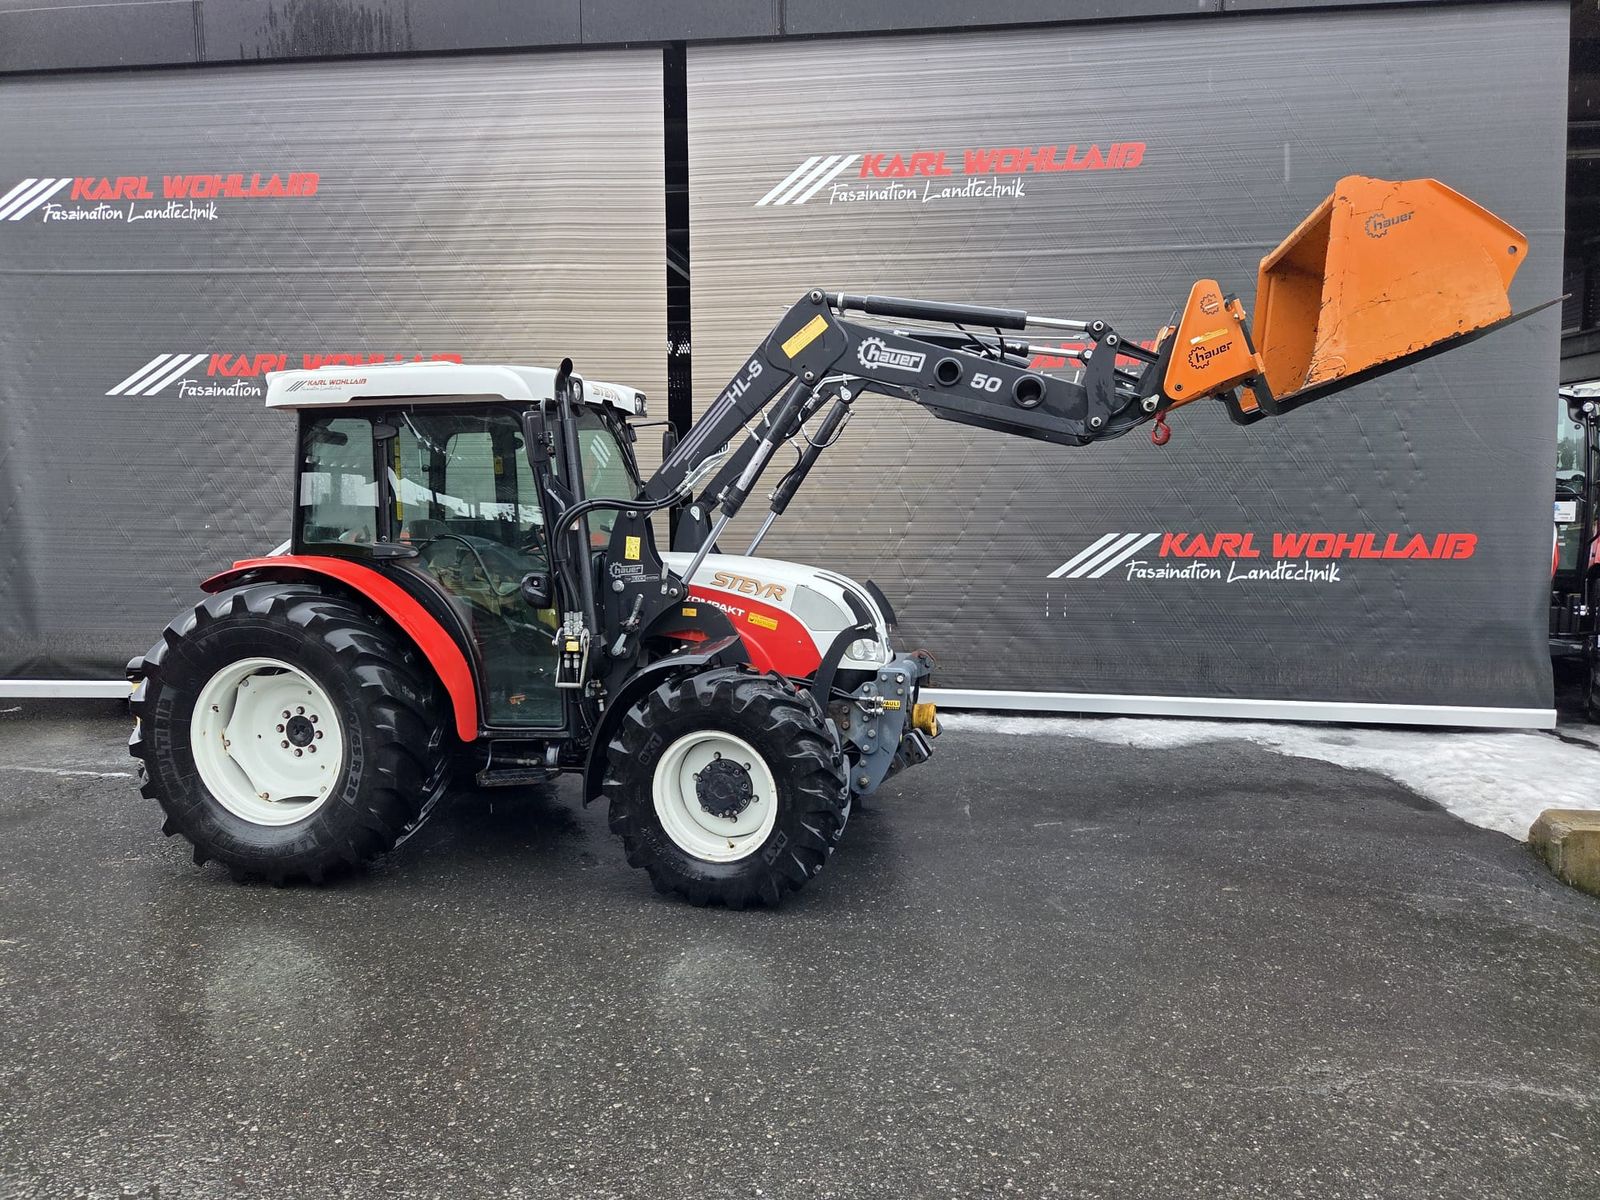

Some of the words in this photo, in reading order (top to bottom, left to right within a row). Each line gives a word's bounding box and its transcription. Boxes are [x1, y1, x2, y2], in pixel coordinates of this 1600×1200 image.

[859, 151, 954, 179] KARL
[963, 141, 1147, 175] WOHLLAIB
[71, 175, 153, 200] KARL
[163, 172, 320, 199] WOHLLAIB
[828, 181, 917, 205] Faszination
[922, 176, 1025, 204] Landtechnik
[42, 202, 123, 223] Faszination
[127, 200, 218, 223] Landtechnik
[1373, 211, 1415, 232] hauer
[866, 344, 921, 367] hauer
[1195, 341, 1233, 363] hauer
[177, 378, 261, 399] Faszination
[727, 359, 763, 405] HL-S
[970, 372, 1003, 393] 50
[1159, 532, 1260, 558] KARL
[1271, 532, 1479, 560] WOHLLAIB
[614, 565, 641, 574] hauer
[1125, 559, 1222, 583] Faszination
[1226, 559, 1341, 584] Landtechnik
[710, 571, 787, 602] STEYR
